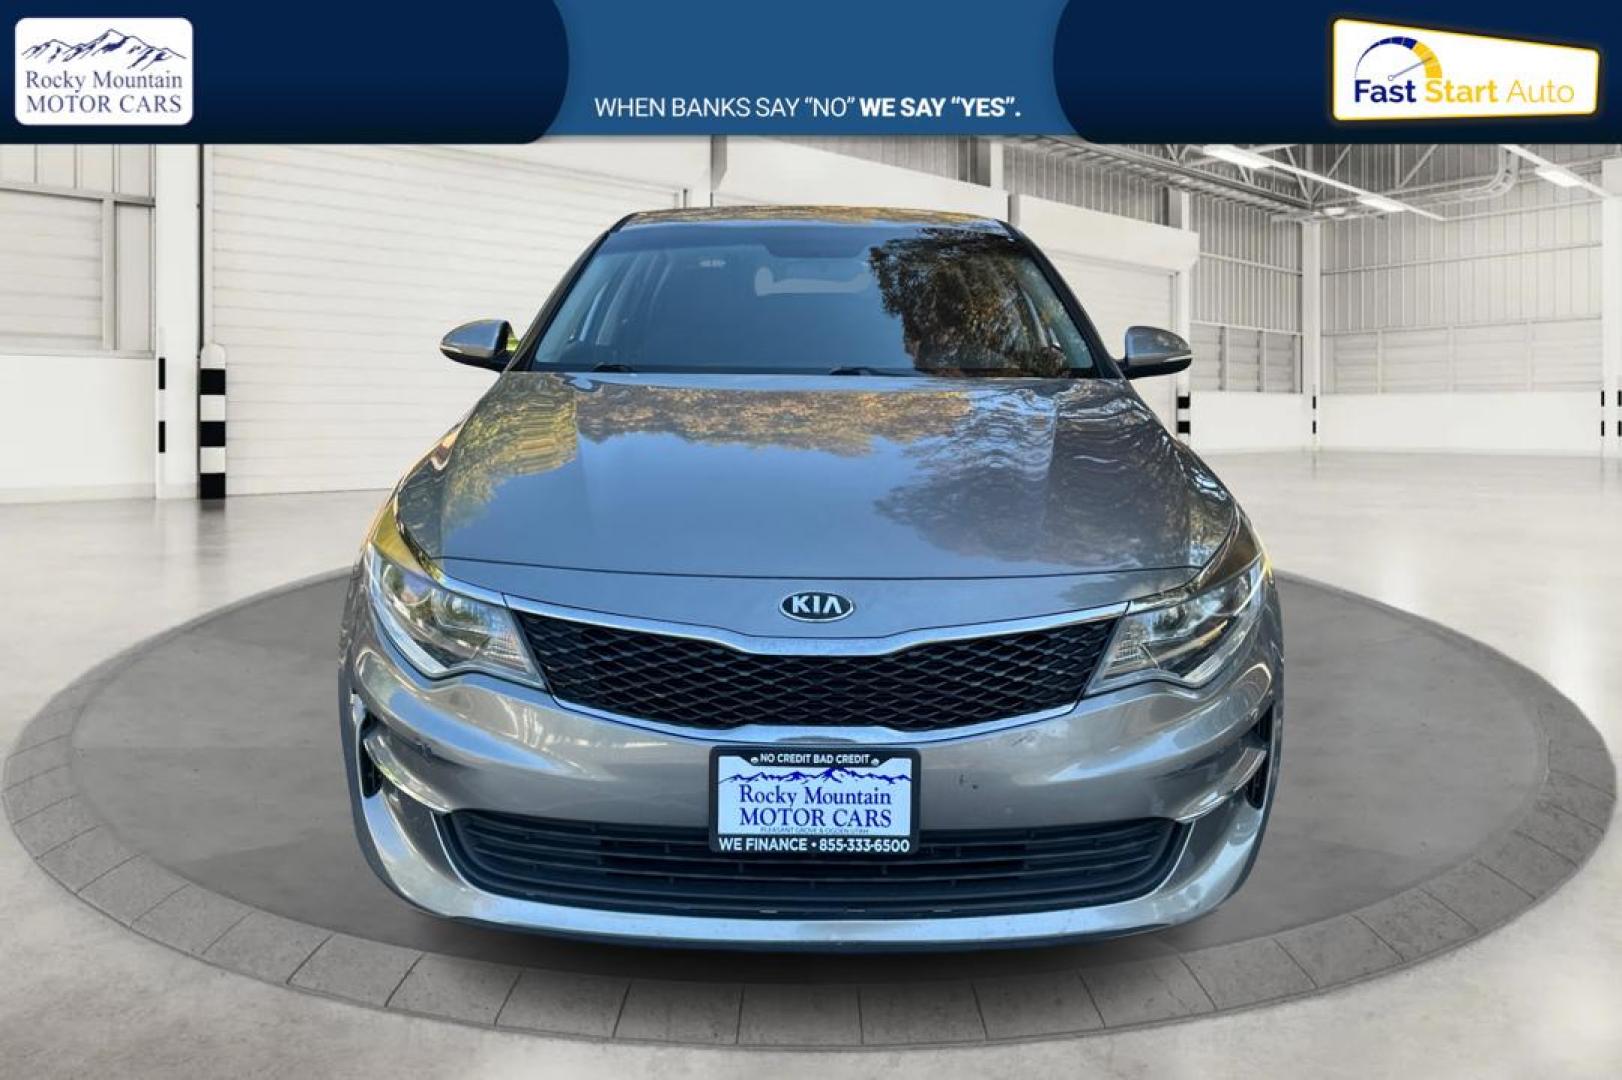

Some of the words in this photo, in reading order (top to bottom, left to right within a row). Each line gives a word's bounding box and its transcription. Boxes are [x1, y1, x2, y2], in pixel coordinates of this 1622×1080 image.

[792, 595, 842, 614] KIA
[760, 754, 776, 763] NO
[778, 754, 811, 764] CREDIT
[814, 754, 836, 764] BAD
[837, 754, 870, 764] CREDIT
[739, 784, 797, 807] Rocky
[804, 786, 892, 805] Mountain
[739, 808, 825, 827] MOTOR
[832, 808, 892, 828] CARS
[718, 837, 742, 851] WE
[745, 837, 808, 851] FINANCE
[819, 838, 911, 853] 855-333-6500
